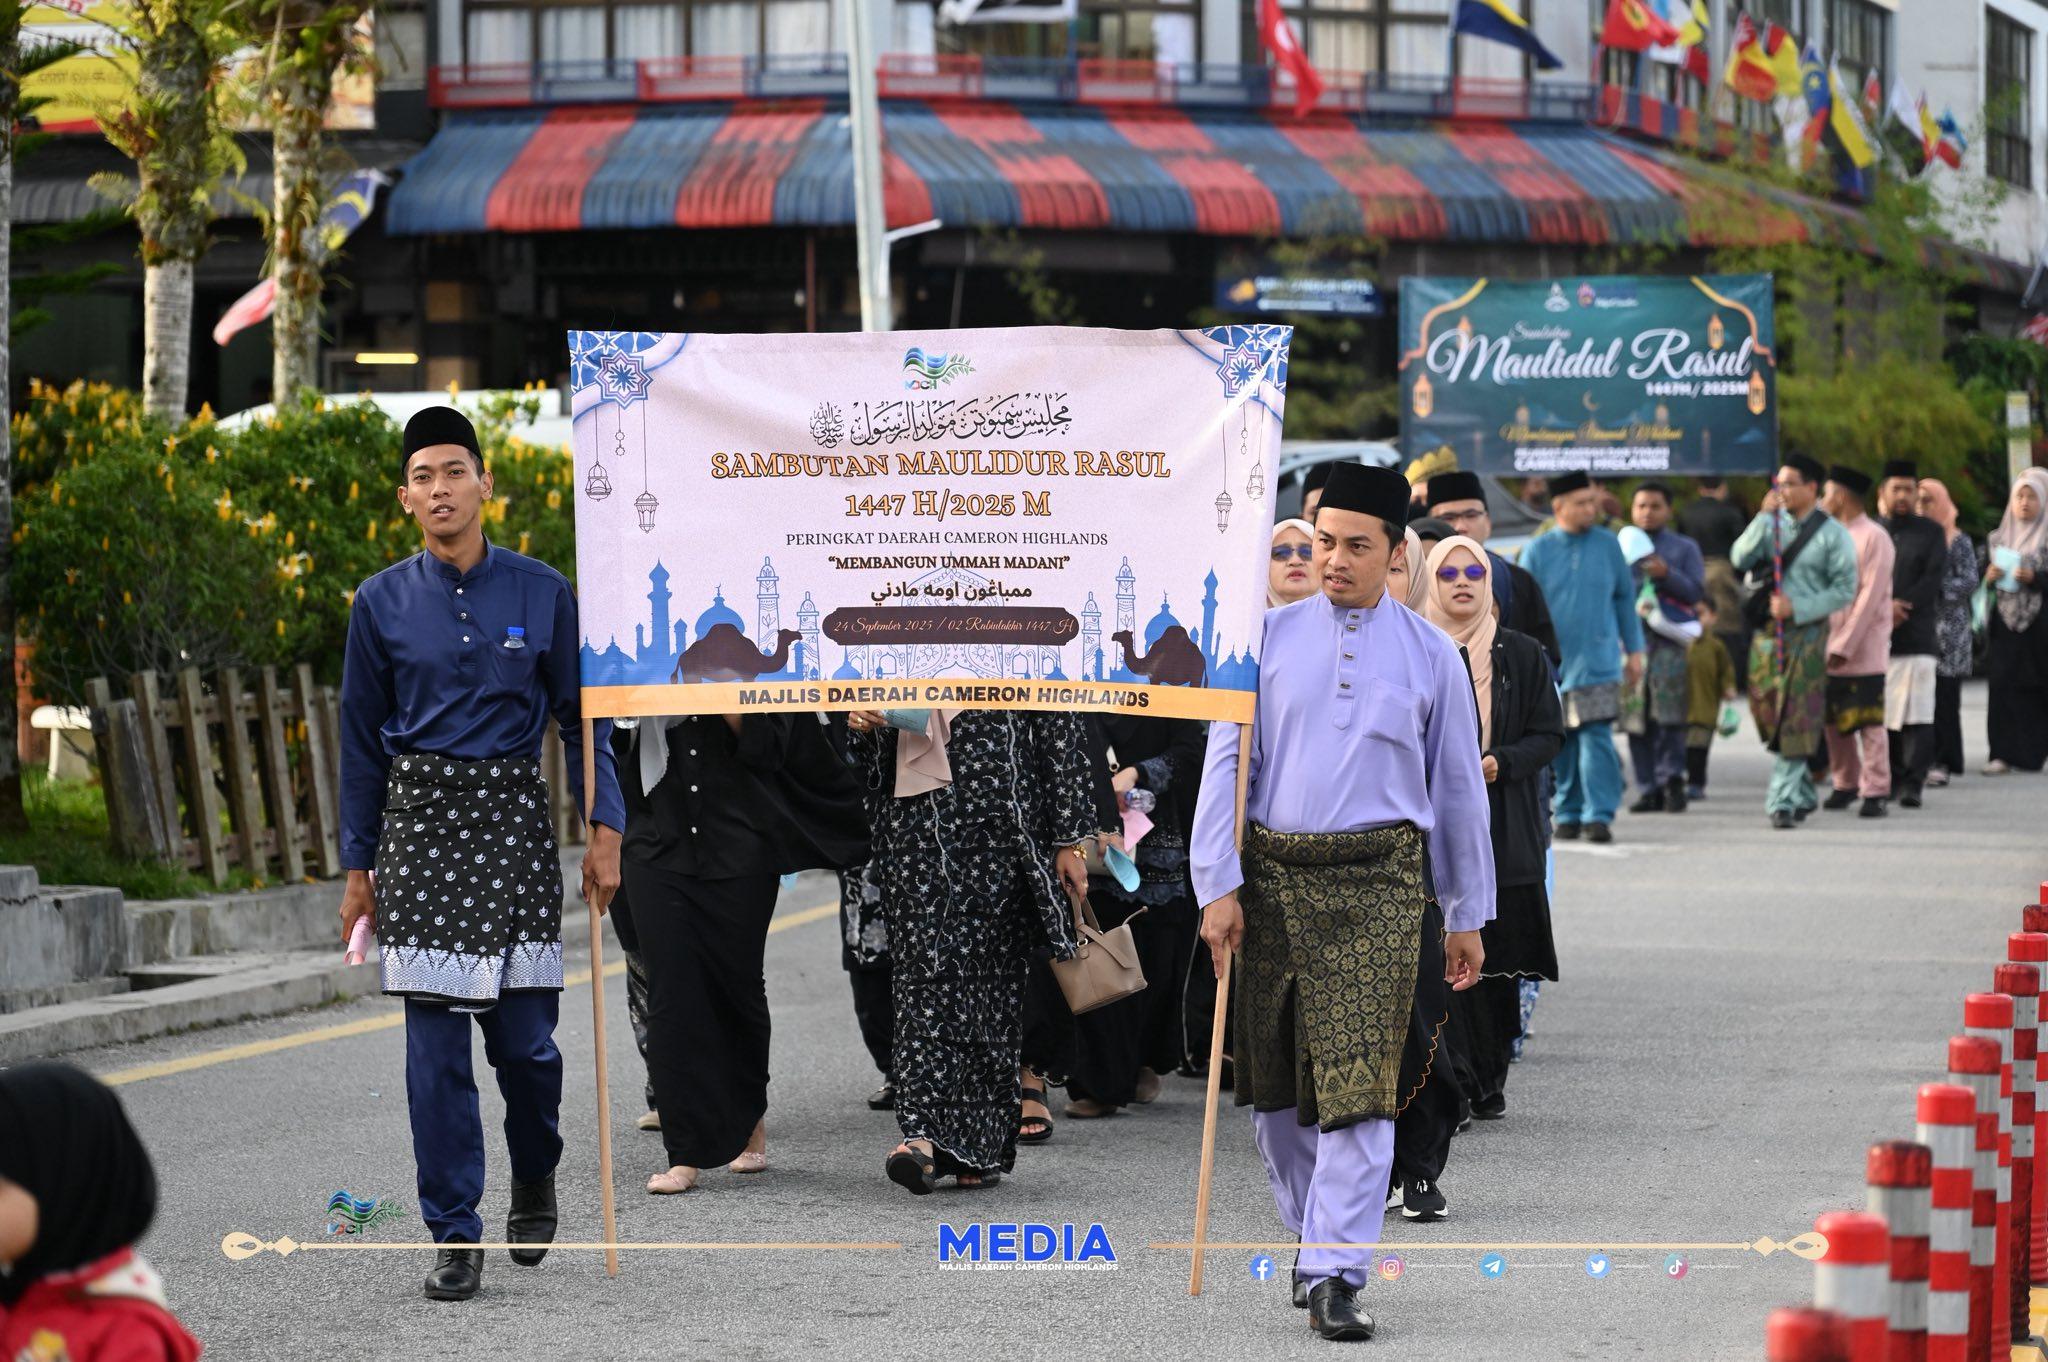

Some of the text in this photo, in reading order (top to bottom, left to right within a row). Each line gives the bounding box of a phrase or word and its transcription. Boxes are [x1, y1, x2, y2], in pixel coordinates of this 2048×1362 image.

[1426, 327, 1754, 385] Maulidul Rasul
[711, 450, 1171, 479] SAMBUTAN MAULIDUR RASUL
[845, 488, 1051, 522] 1447 H/2025 M
[786, 531, 1108, 546] PERINGKAT DAERAH CAMERON HIGHLANDS
[941, 555, 1001, 569] UMMAH
[833, 621, 849, 632] 24
[851, 617, 902, 635] September
[904, 620, 933, 631] 2025
[948, 620, 964, 631] 02
[965, 617, 1023, 632] Rabiulakhir
[1026, 620, 1052, 632] 1447
[1053, 618, 1075, 635] H
[739, 686, 1150, 708] MAJLIS DAERAH CAMERON HIGHLANDS
